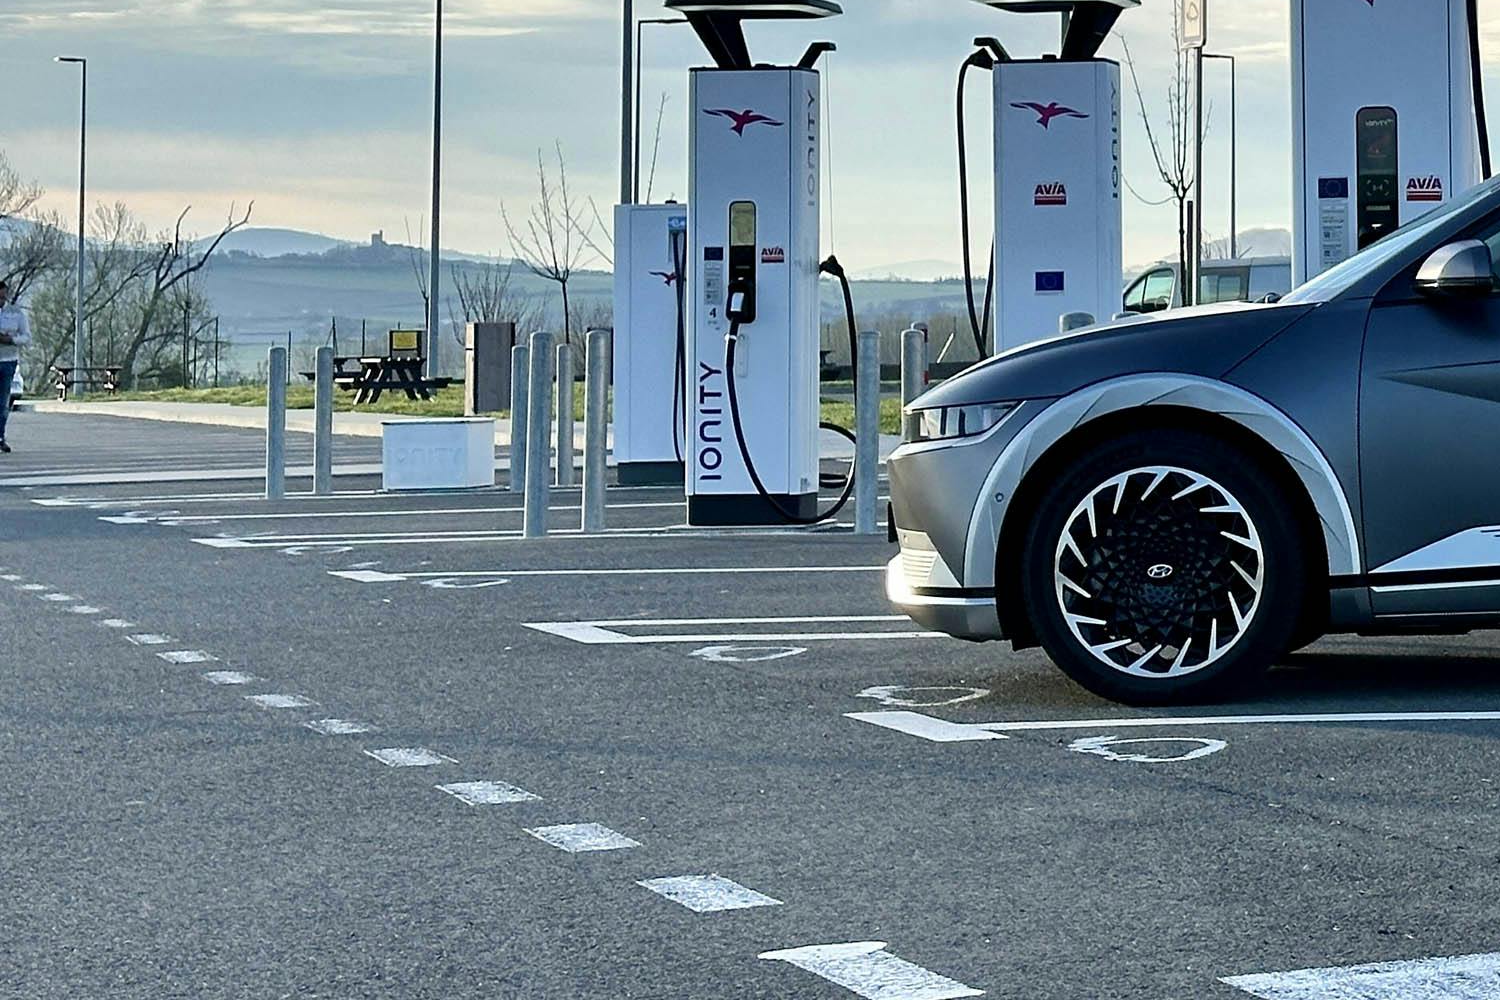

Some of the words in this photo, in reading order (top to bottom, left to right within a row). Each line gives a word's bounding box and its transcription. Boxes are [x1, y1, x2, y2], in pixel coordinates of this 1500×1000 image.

[807, 88, 815, 206] IONITY
[1110, 80, 1118, 199] IONITY
[1034, 181, 1066, 195] AVIA
[1406, 175, 1442, 190] AVIA
[761, 246, 784, 256] AVIA
[709, 307, 717, 318] 4
[699, 361, 722, 480] IONITY
